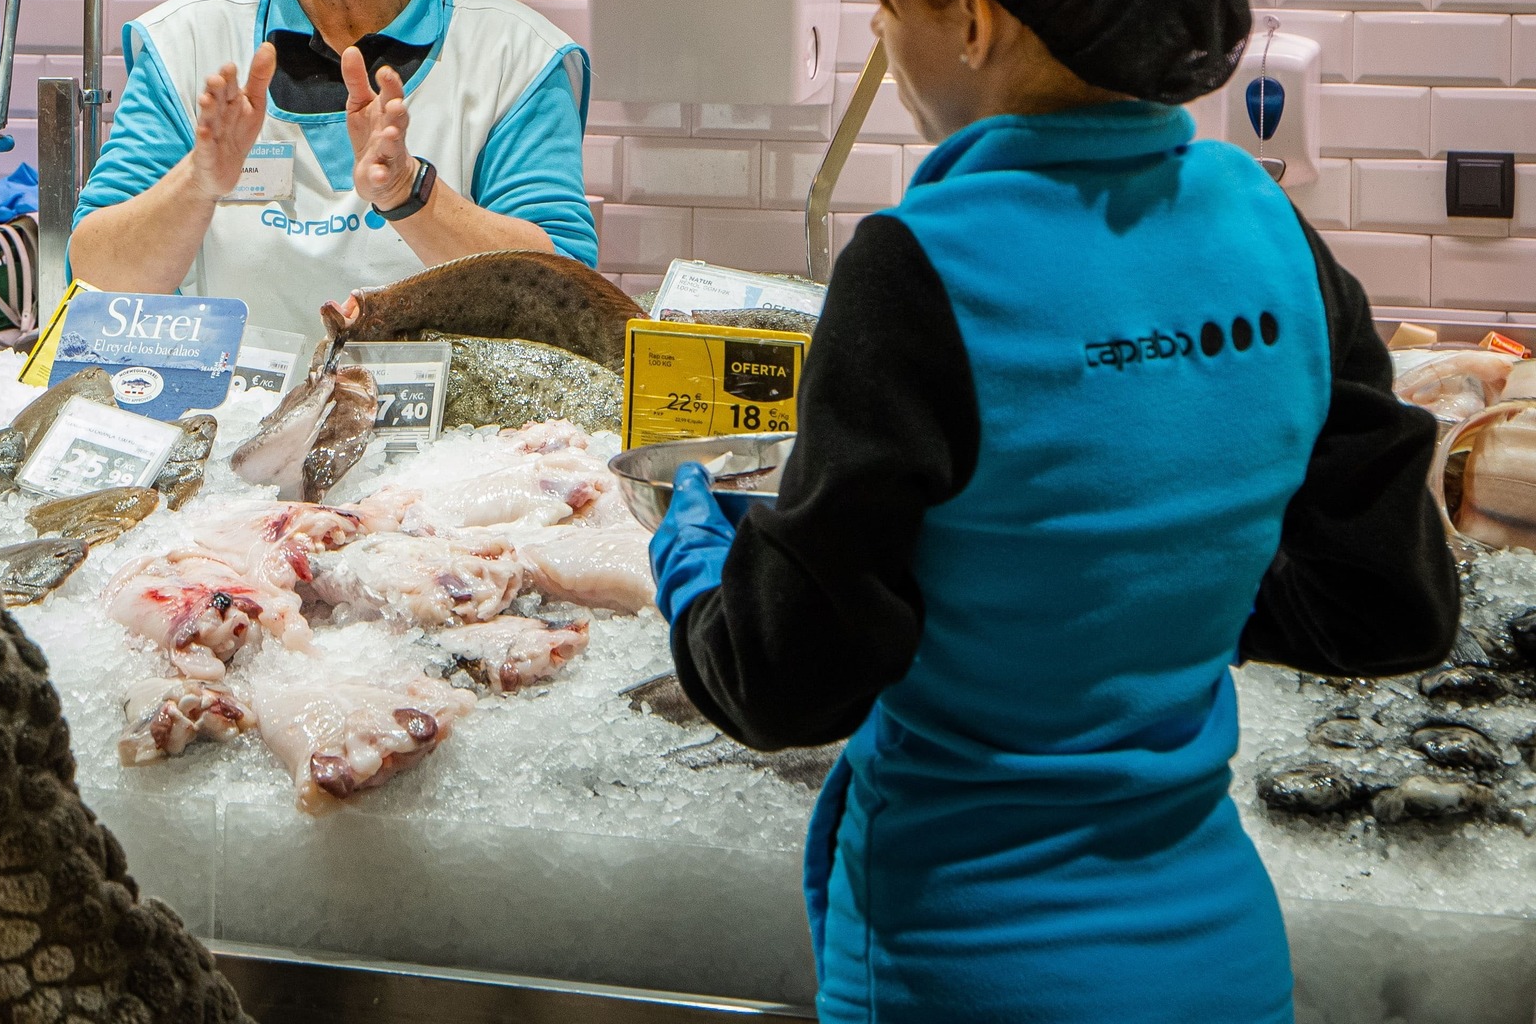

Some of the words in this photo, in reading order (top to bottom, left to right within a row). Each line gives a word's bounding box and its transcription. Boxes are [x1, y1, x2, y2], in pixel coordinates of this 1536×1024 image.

[248, 146, 285, 157] udar-te?
[260, 209, 361, 237] caprabo
[689, 276, 713, 286] NATUR
[102, 297, 206, 342] Skrei
[94, 338, 106, 351] El
[106, 342, 122, 356] rey
[124, 342, 138, 354] de
[138, 342, 153, 355] los
[155, 342, 201, 358] bacalaos
[648, 352, 662, 362] Rap
[731, 362, 787, 378] OFERTA
